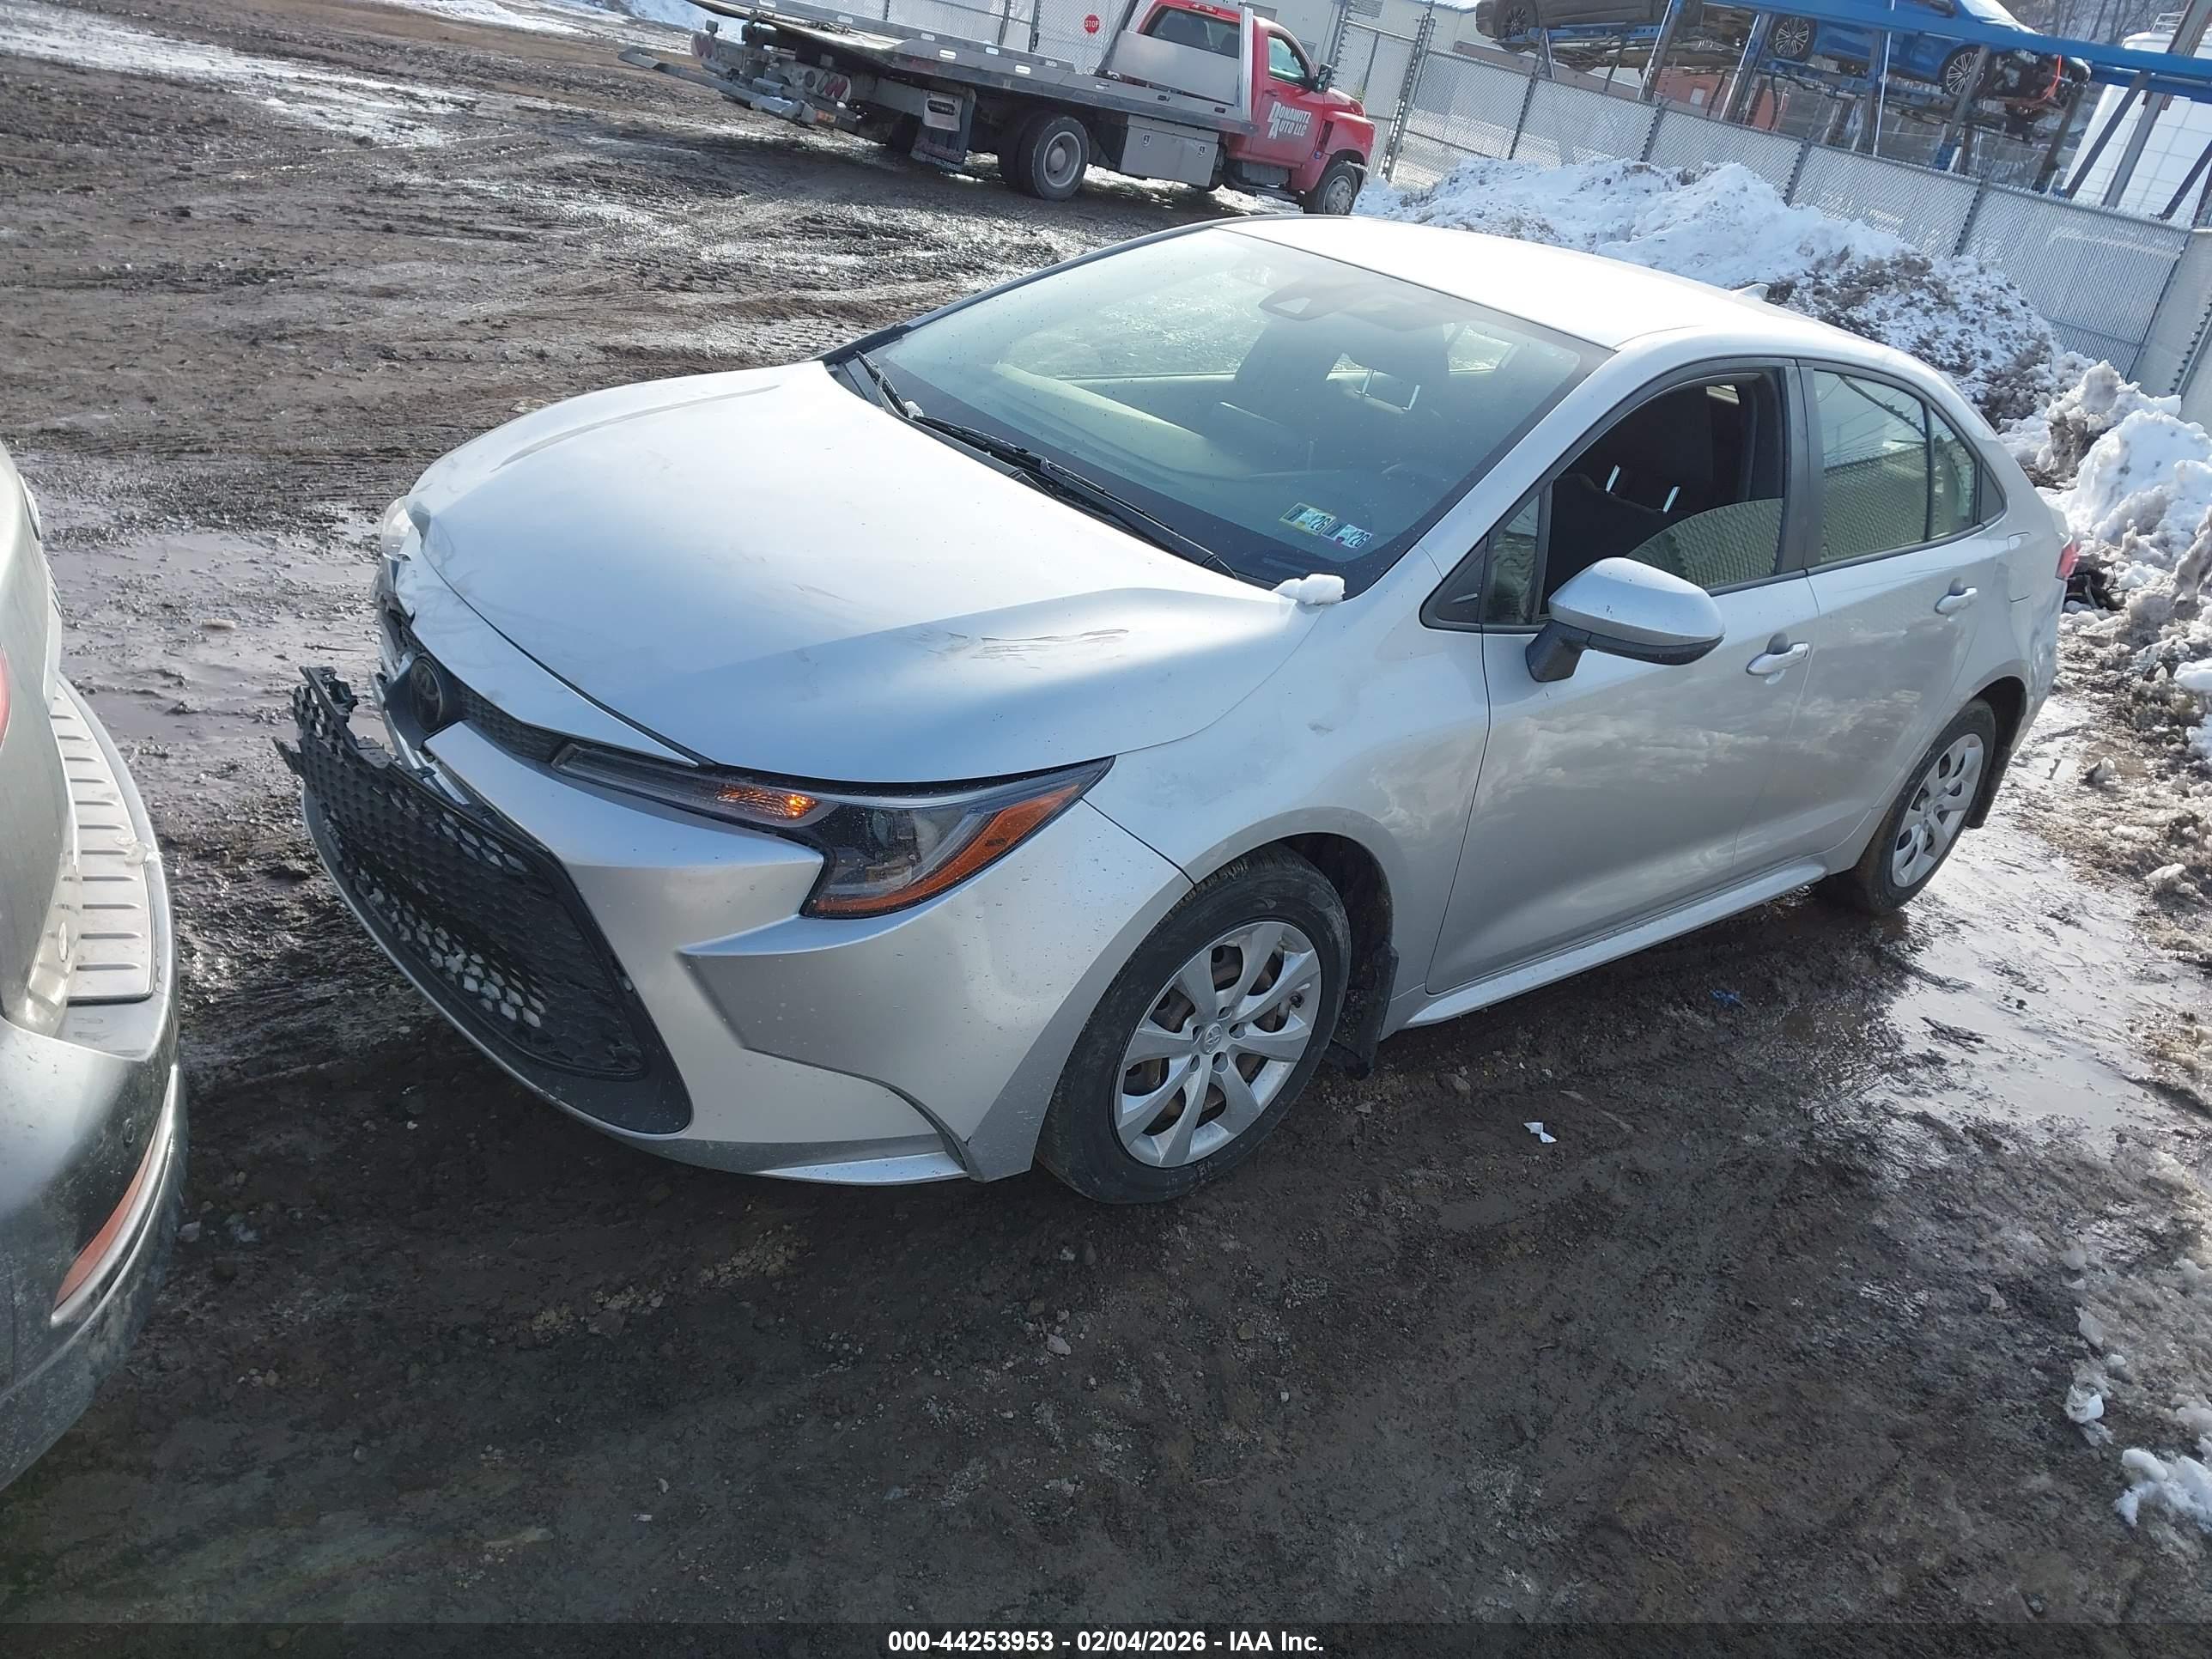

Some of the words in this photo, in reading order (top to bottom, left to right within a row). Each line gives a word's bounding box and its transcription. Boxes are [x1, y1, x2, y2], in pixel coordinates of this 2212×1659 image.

[1085, 20, 1099, 28] STOP
[1267, 100, 1313, 125] DONAWITZ
[1267, 118, 1295, 140] AUTO
[1293, 122, 1307, 137] LLC
